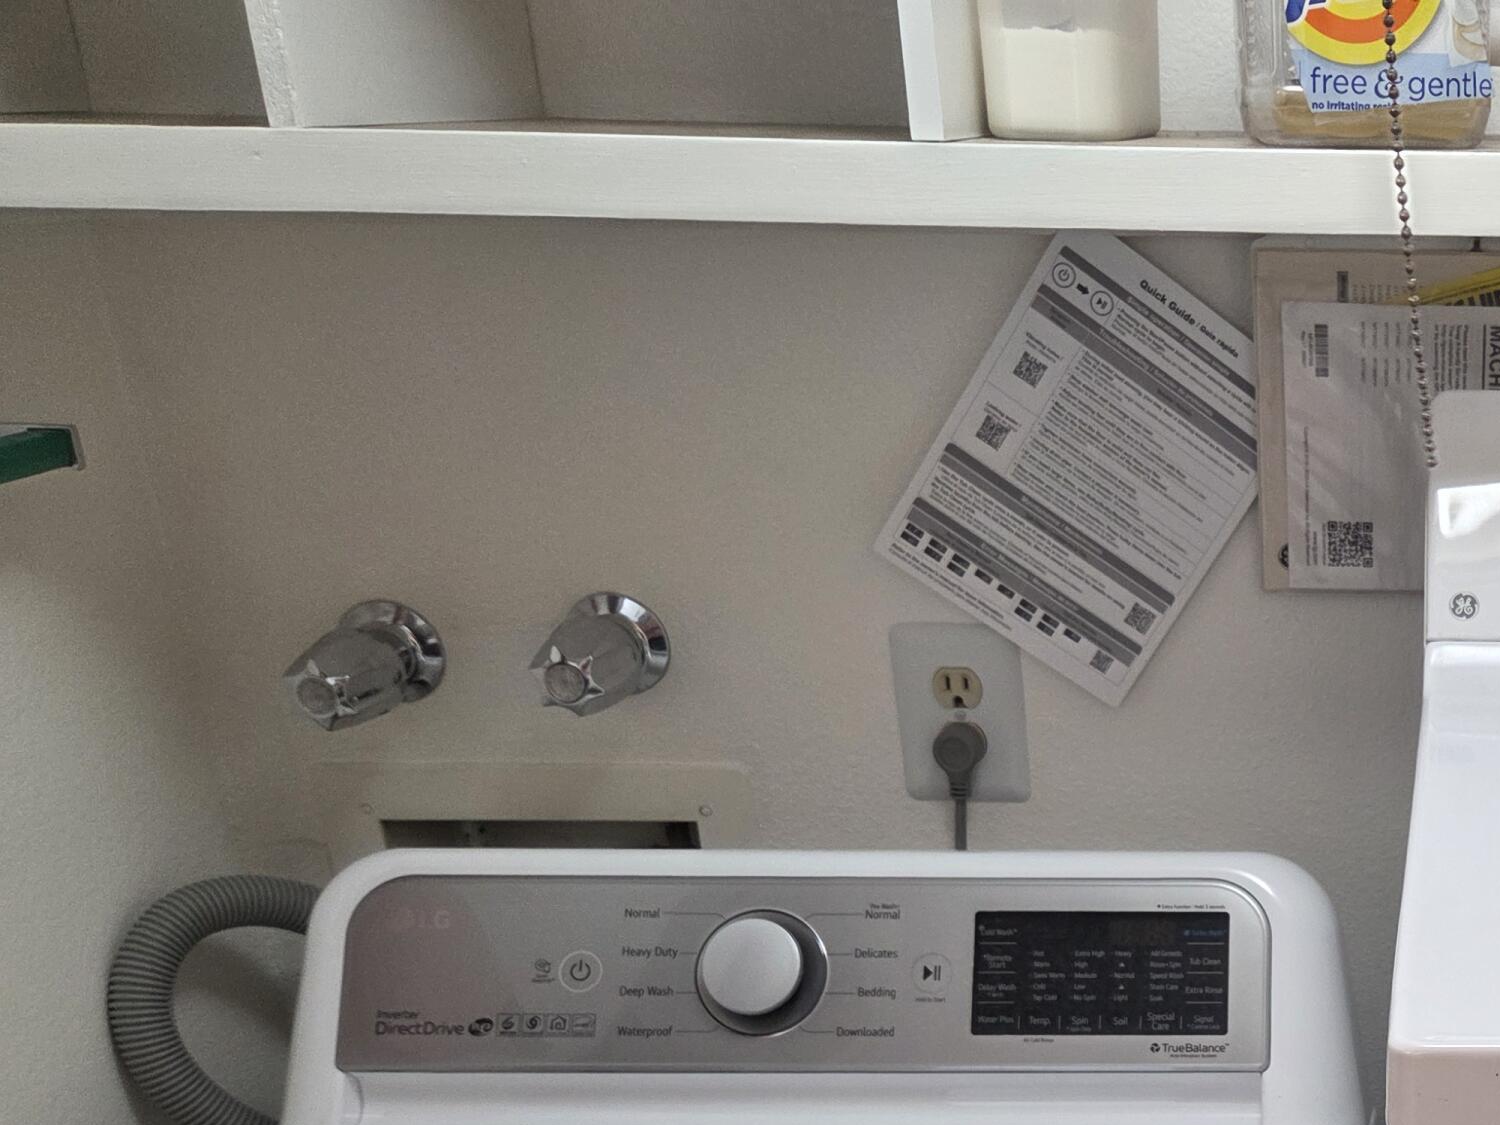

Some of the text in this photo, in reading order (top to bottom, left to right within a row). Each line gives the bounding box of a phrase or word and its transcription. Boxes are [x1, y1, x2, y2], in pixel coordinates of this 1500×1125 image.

[1310, 67, 1367, 94] free
[1408, 71, 1493, 101] gentle
[1140, 280, 1167, 304] Quick
[1169, 301, 1196, 325] Guide
[624, 908, 660, 918] Normal
[865, 910, 900, 919] Normal
[622, 947, 678, 959] Heavy Duty
[854, 948, 898, 958] Delicates
[619, 986, 673, 998] Deep Wash
[858, 987, 896, 999] Bedding
[1072, 1016, 1088, 1026] Spin
[1113, 1016, 1128, 1026] Soil
[1147, 1012, 1176, 1022] Special
[618, 1025, 673, 1038] Waterproof
[836, 1027, 895, 1037] Downloaded
[1152, 1023, 1170, 1031] Care
